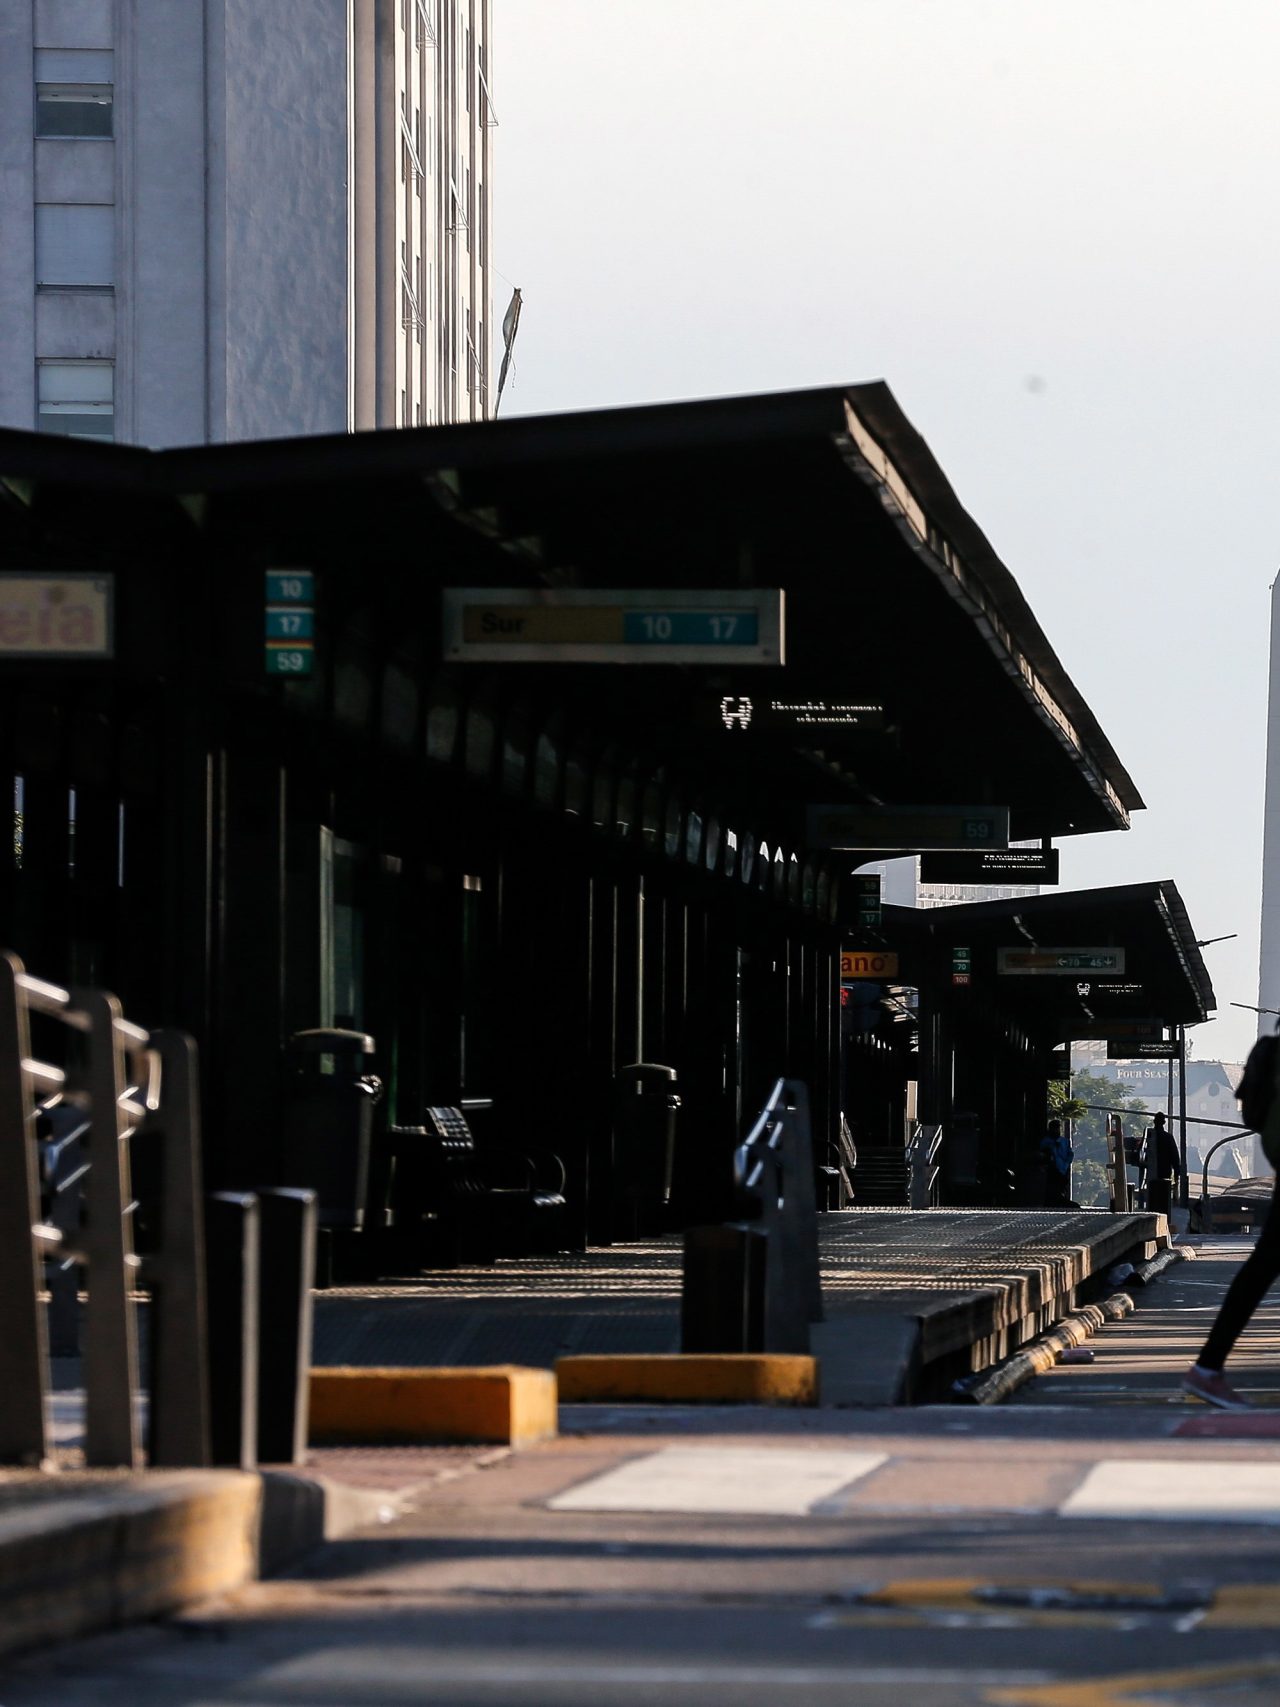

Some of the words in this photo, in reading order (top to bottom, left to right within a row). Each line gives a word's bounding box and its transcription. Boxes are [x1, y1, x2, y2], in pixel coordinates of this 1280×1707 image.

[280, 579, 303, 598] 10
[279, 616, 303, 635] 17
[481, 611, 525, 634] Sur
[641, 615, 673, 640] 10
[707, 615, 738, 640] 17
[277, 652, 304, 672] 59
[965, 821, 989, 838] 59
[865, 914, 877, 924] 17
[956, 963, 967, 971] 70
[955, 976, 968, 984] 100
